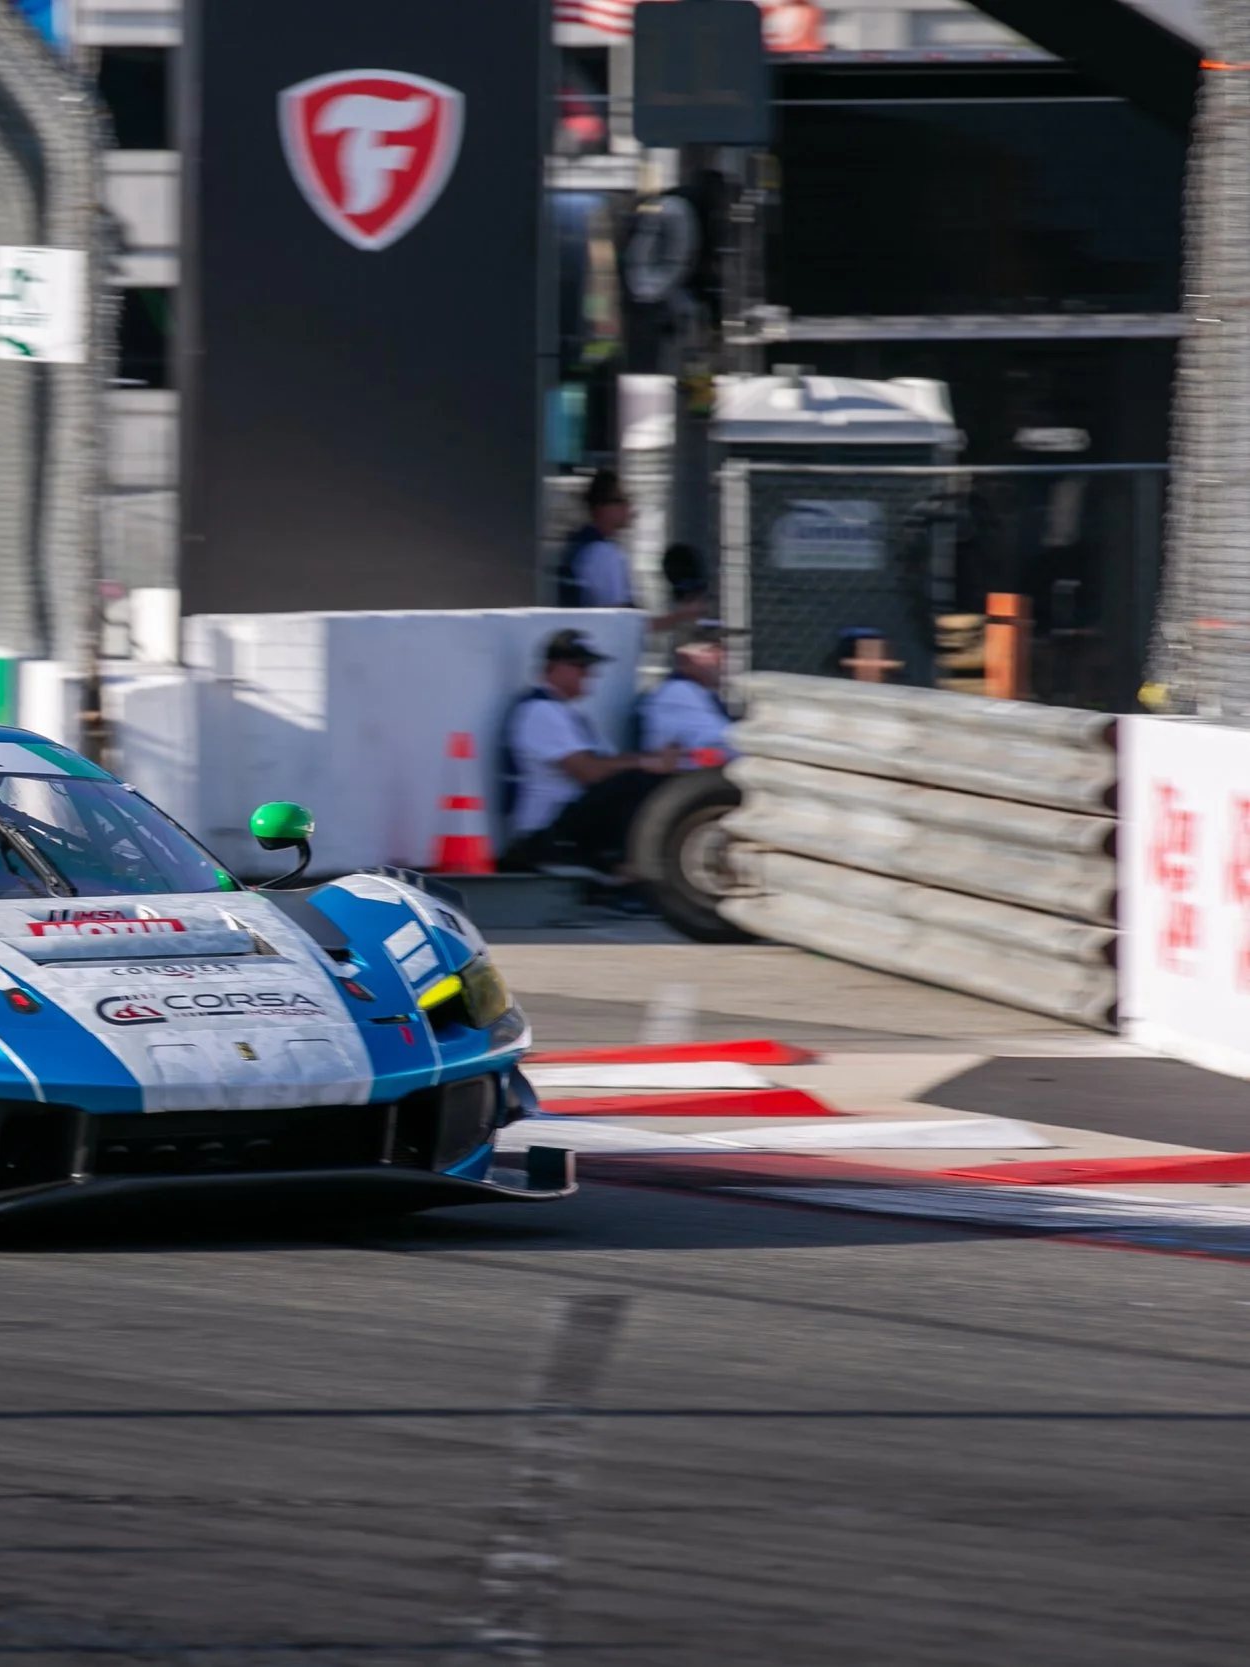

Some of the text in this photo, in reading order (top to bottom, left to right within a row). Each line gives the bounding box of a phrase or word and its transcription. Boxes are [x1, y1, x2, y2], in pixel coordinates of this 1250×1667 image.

[110, 963, 241, 977] CONQUEST
[162, 992, 322, 1010] CORSA
[244, 1007, 328, 1017] HORIZON
